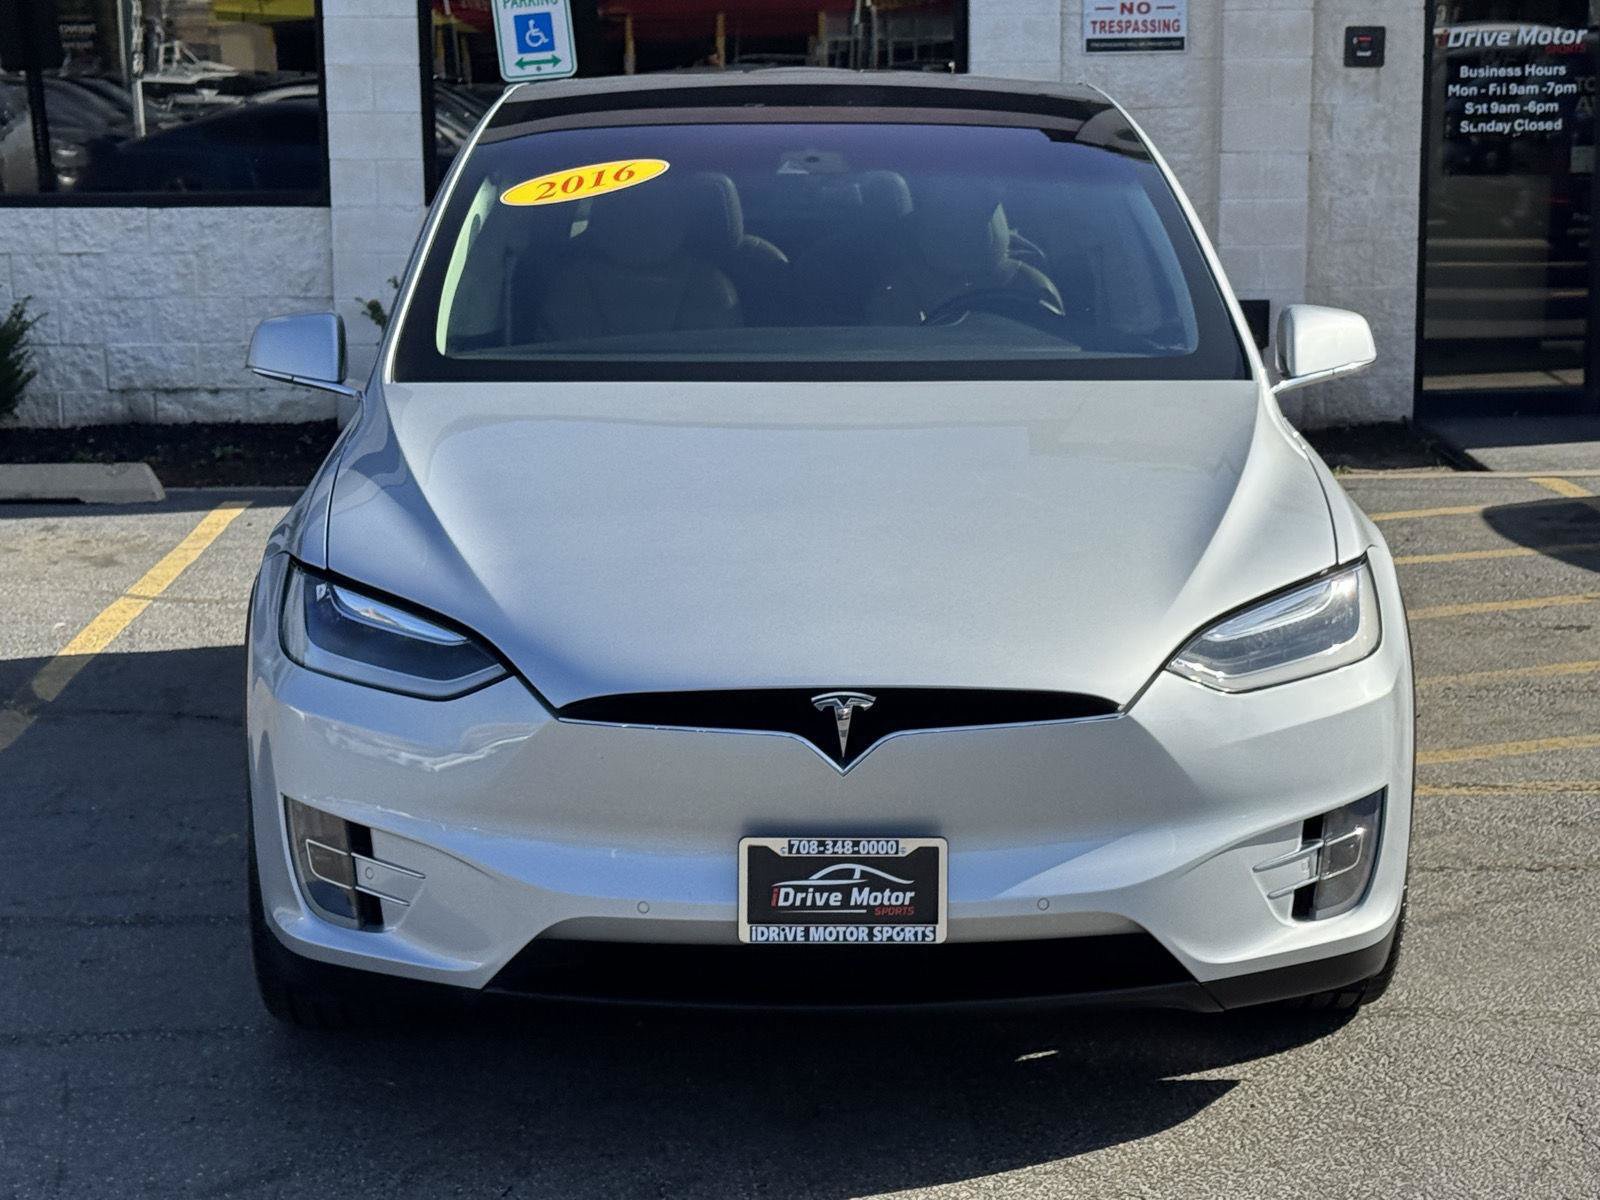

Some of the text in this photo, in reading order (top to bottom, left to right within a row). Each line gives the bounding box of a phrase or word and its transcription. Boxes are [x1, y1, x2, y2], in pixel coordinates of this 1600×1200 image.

[1120, 2, 1151, 15] NO
[1090, 19, 1180, 34] TRESPASSING
[1517, 25, 1588, 46] Motor
[1459, 64, 1567, 79] Business Hours
[1448, 84, 1478, 97] Mon
[1509, 83, 1539, 95] 9am
[1490, 101, 1520, 114] 9am
[1513, 118, 1563, 132] Closed
[534, 163, 635, 201] 2016
[790, 840, 898, 855] 708-348-0000
[770, 886, 916, 907] iDrive Motor
[874, 906, 915, 917] SPORTS
[809, 926, 869, 942] MOTOR
[873, 926, 935, 942] SPORTS
